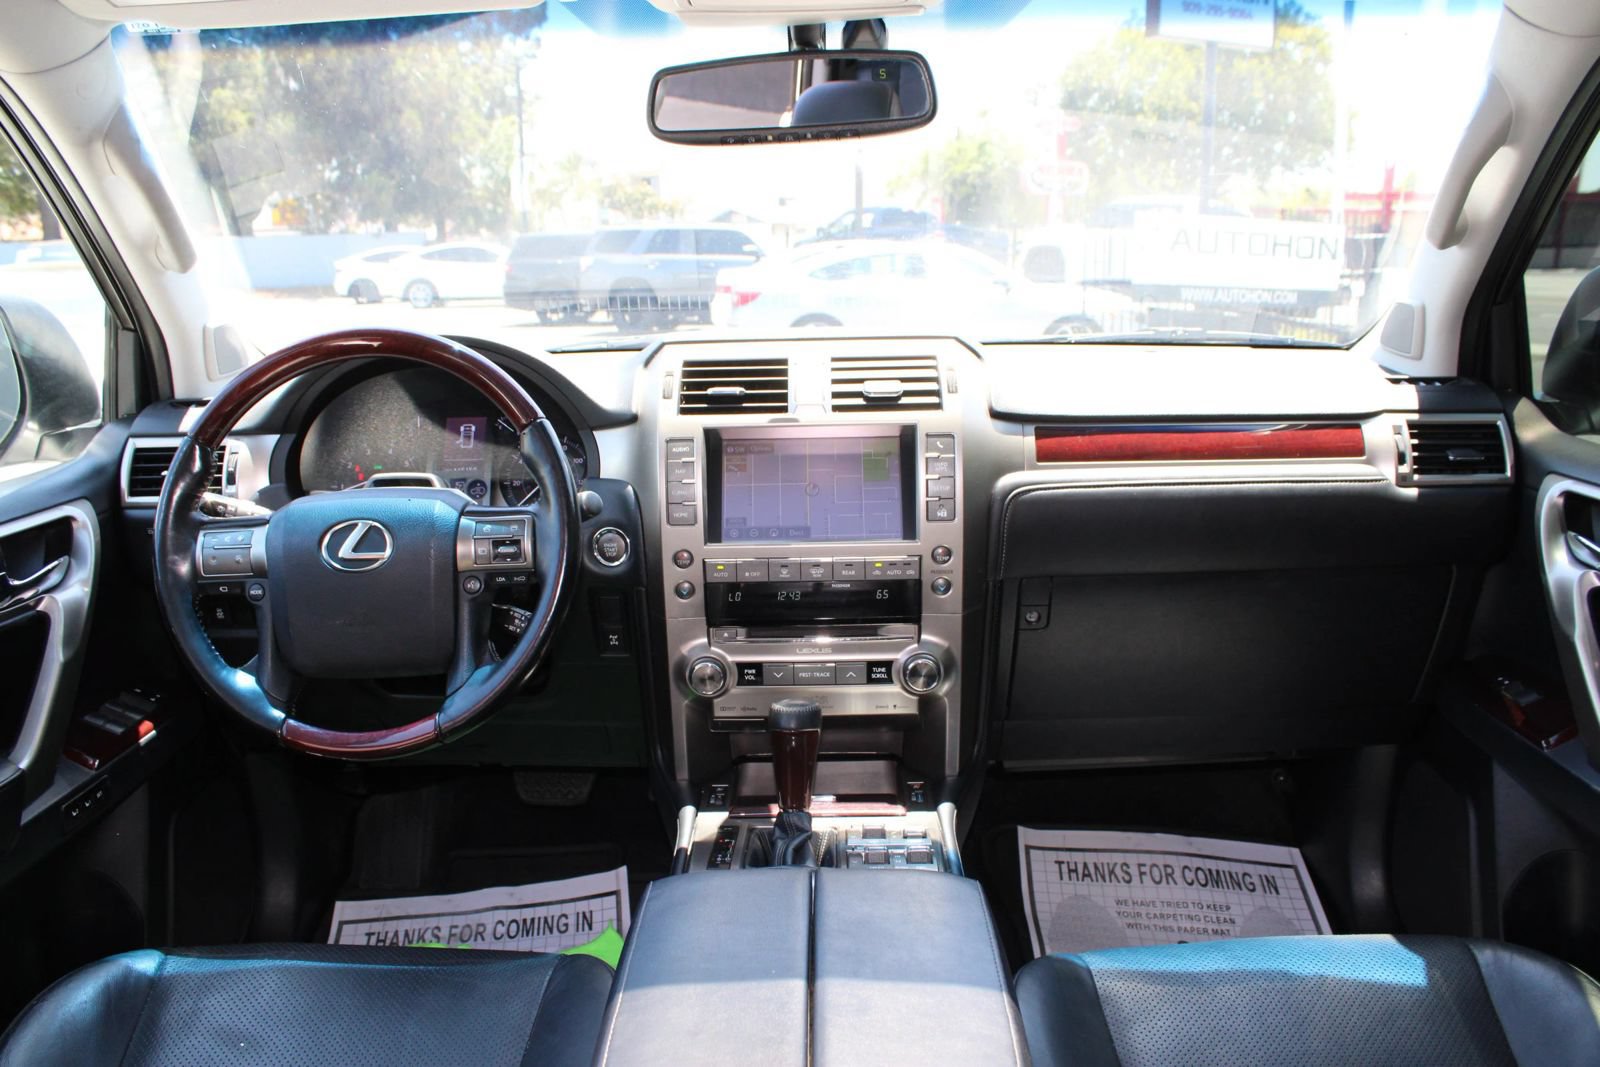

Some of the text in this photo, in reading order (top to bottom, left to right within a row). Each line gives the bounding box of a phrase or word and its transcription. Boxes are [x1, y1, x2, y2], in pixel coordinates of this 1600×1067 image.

[1170, 228, 1339, 261] AUTOHON
[875, 589, 889, 600] 65
[1054, 860, 1280, 895] THANKS FOR COMING IN
[1114, 898, 1232, 912] WE HAVE TRIED TO KEEP
[1115, 910, 1236, 925] YOUR CARPETING CLEAN
[364, 910, 594, 946] THANKS FOR COMING IN
[1126, 922, 1232, 937] WITH THIS PAPER MAT
